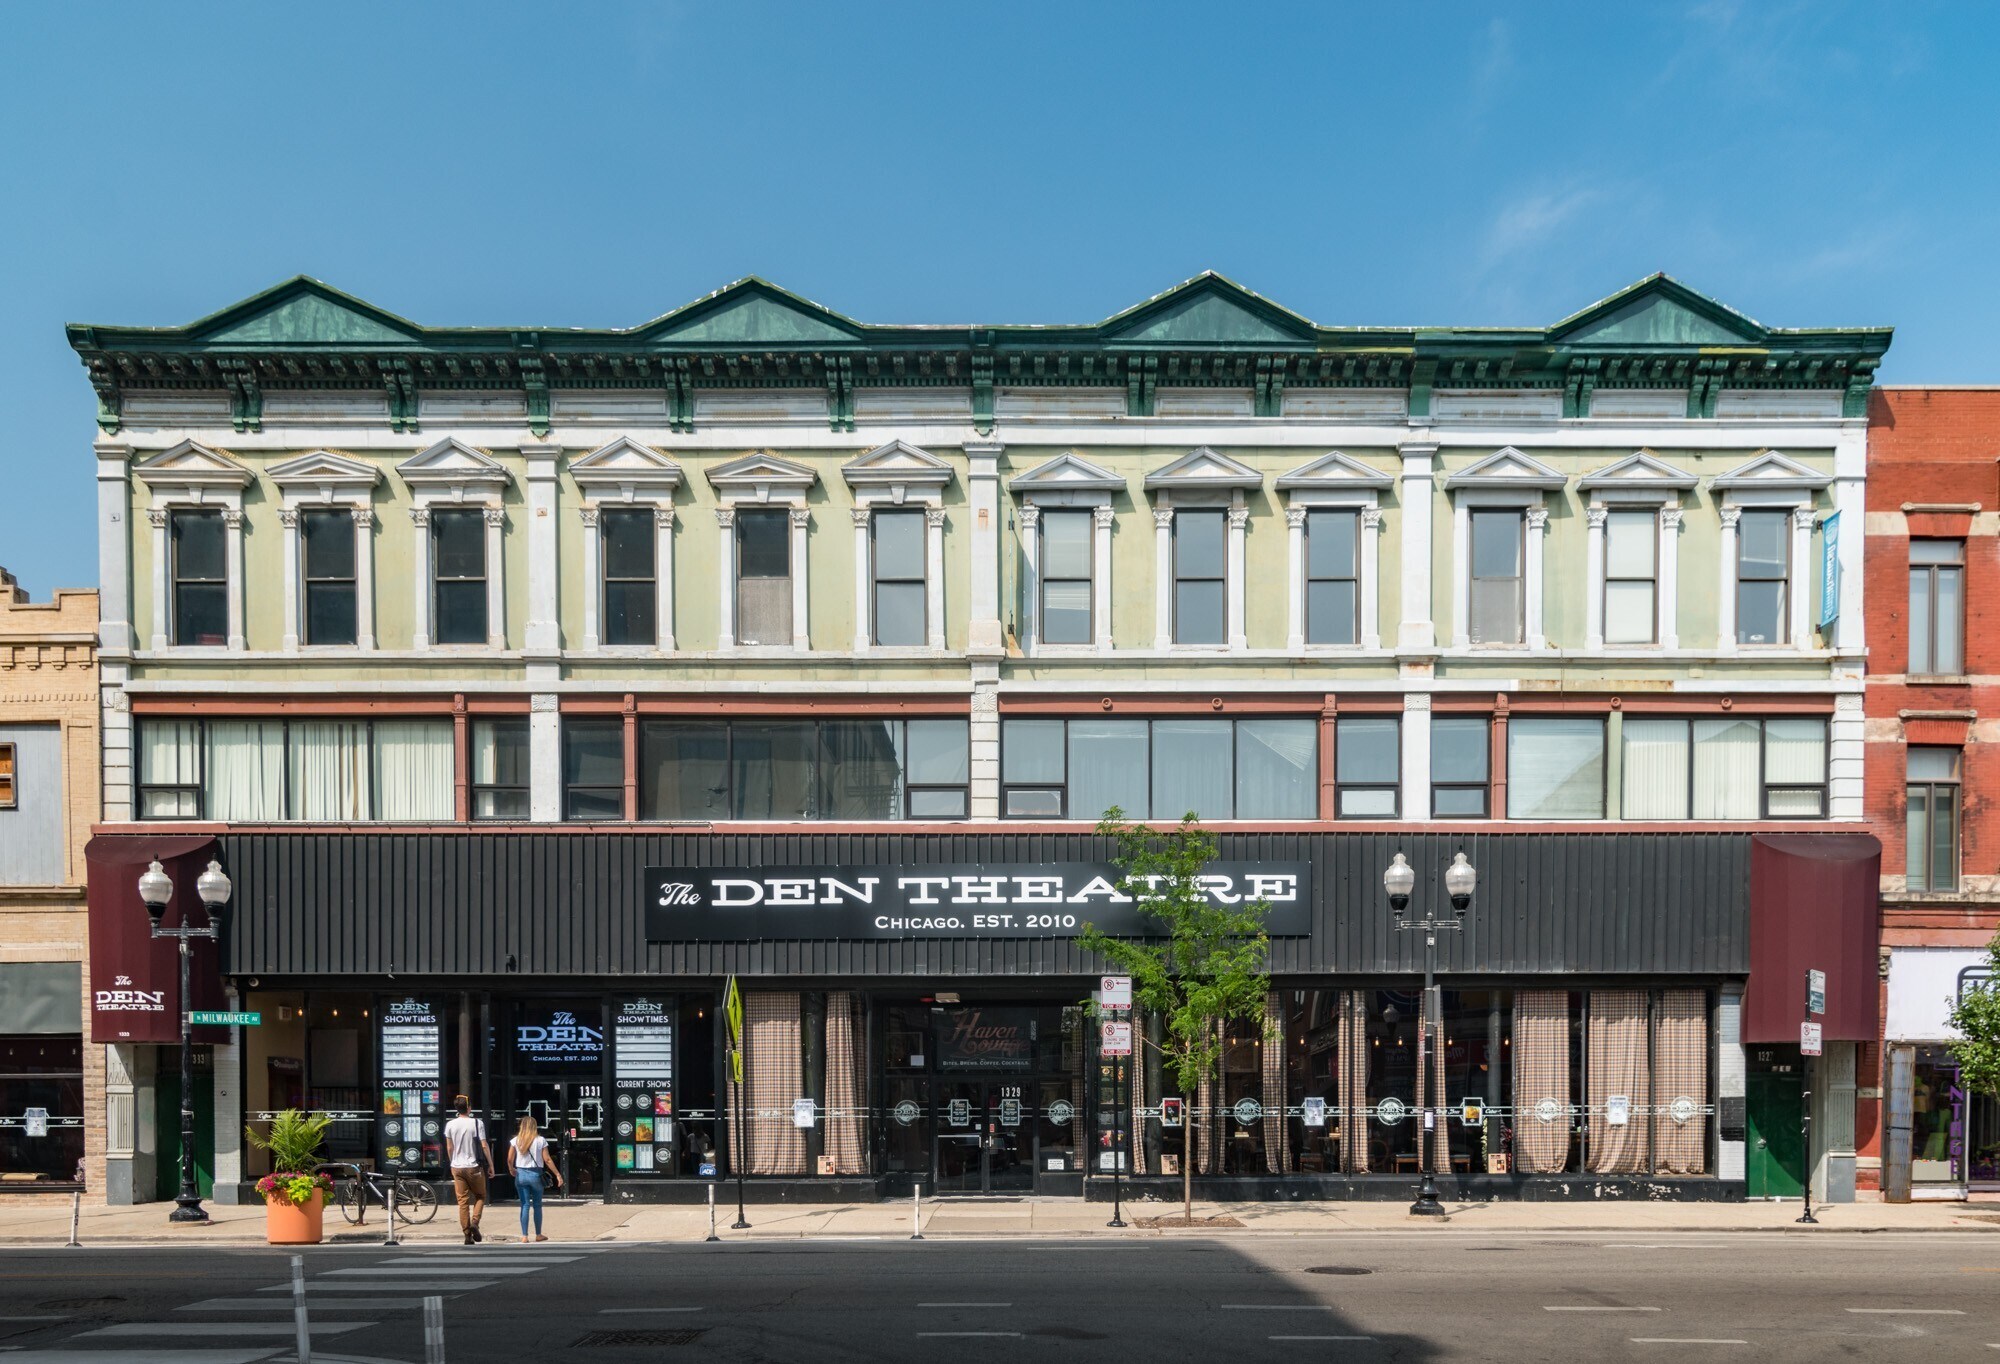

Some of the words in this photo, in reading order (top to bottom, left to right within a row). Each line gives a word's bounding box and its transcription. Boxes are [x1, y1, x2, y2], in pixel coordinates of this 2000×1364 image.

[659, 882, 701, 906] The
[712, 878, 880, 906] DEN
[874, 915, 964, 929] CHICAGO.
[973, 914, 1018, 928] EST.
[1026, 914, 1076, 928] 2010
[115, 975, 132, 986] The
[96, 990, 165, 1004] DEN
[390, 1003, 430, 1011] DEN
[623, 1003, 663, 1011] DEN
[202, 1013, 250, 1024] MILWAUKEE
[384, 1015, 436, 1023] SHOWTIMES
[552, 1011, 577, 1026] The
[617, 1015, 669, 1023] SHOWTIMES
[951, 1011, 1018, 1042] Haven
[517, 1026, 603, 1042] DEN
[517, 1043, 603, 1051] THEATR
[383, 1080, 413, 1088] COMING
[415, 1080, 439, 1088] SOON
[616, 1080, 645, 1088] CURRENT
[646, 1080, 671, 1088] SHOWS
[580, 1085, 600, 1097] 1331
[1001, 1086, 1021, 1098] 1329
